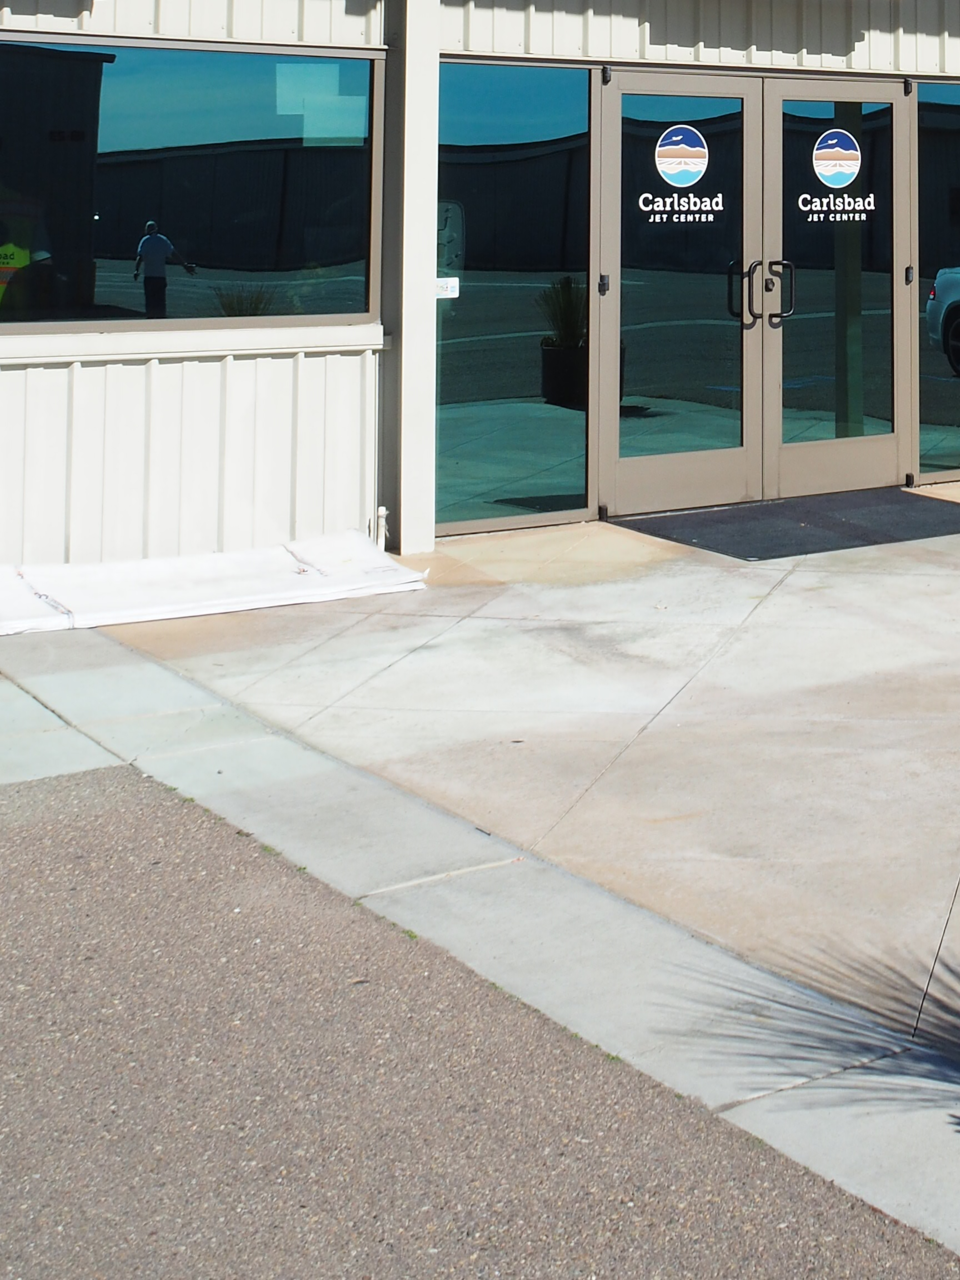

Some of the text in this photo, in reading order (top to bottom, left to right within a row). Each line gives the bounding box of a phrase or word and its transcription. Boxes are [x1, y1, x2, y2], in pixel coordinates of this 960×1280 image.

[638, 192, 724, 211] Carlsbad
[797, 193, 876, 211] Carlsbad
[648, 213, 715, 223] JET CENTER
[807, 213, 867, 222] JET CENTER
